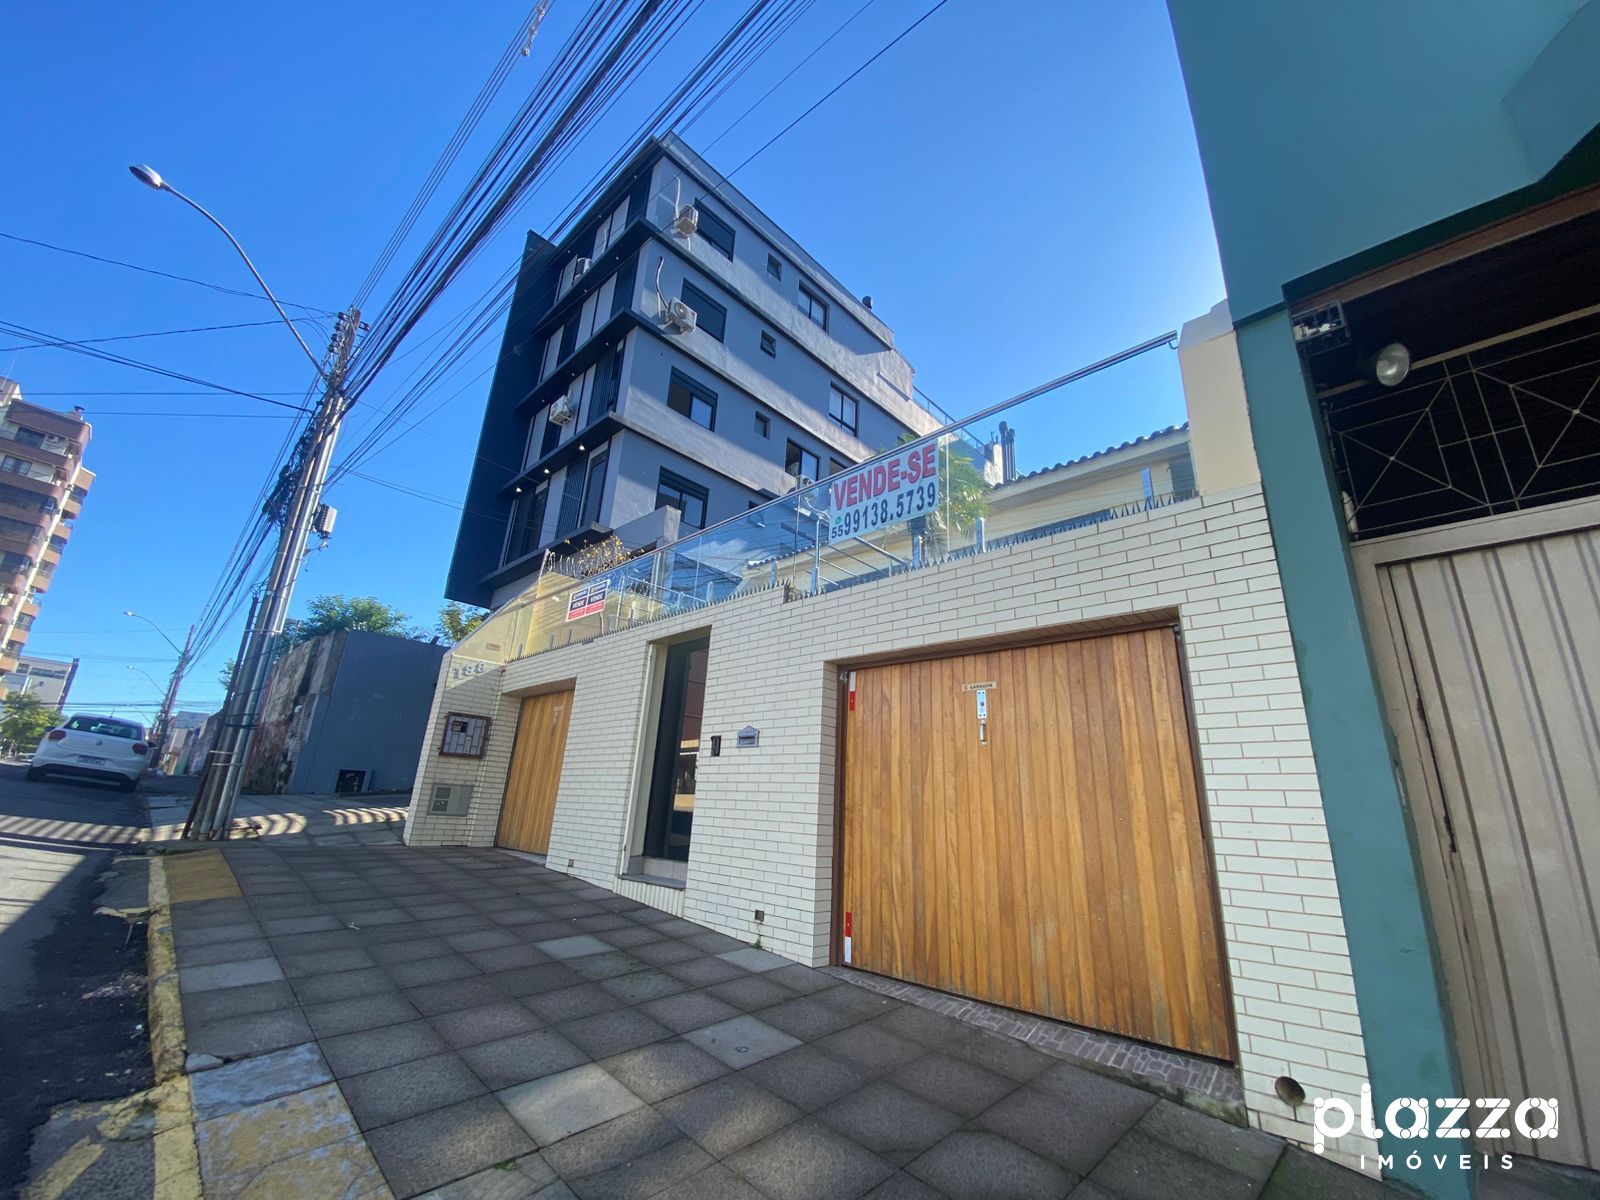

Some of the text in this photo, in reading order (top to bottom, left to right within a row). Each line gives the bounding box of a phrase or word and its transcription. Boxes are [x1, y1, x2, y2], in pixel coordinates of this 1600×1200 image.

[834, 444, 936, 511] VENDE-SE
[831, 482, 936, 539] 55 99138.5739
